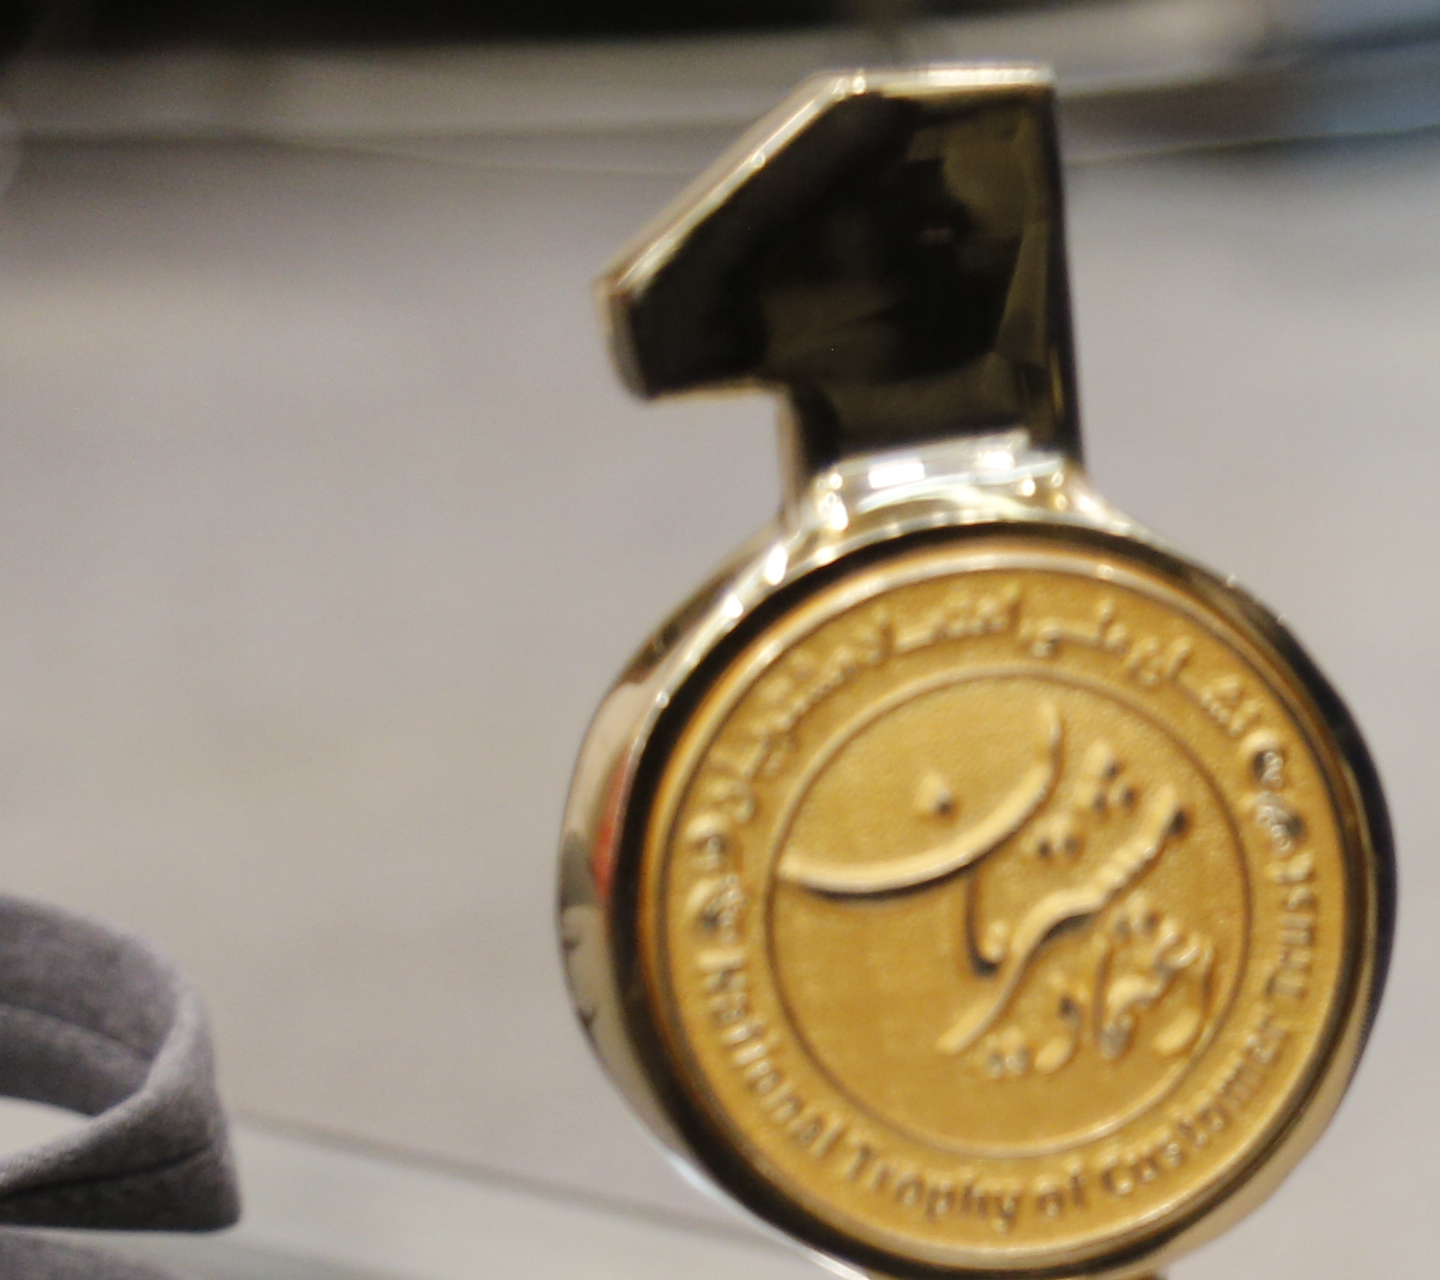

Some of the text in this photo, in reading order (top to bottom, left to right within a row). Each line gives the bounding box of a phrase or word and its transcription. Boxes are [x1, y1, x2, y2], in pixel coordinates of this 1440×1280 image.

[697, 949, 846, 1162] National
[845, 1134, 1021, 1236] Trophy
[1028, 1150, 1087, 1217] of
[1098, 1003, 1292, 1198] Customer
